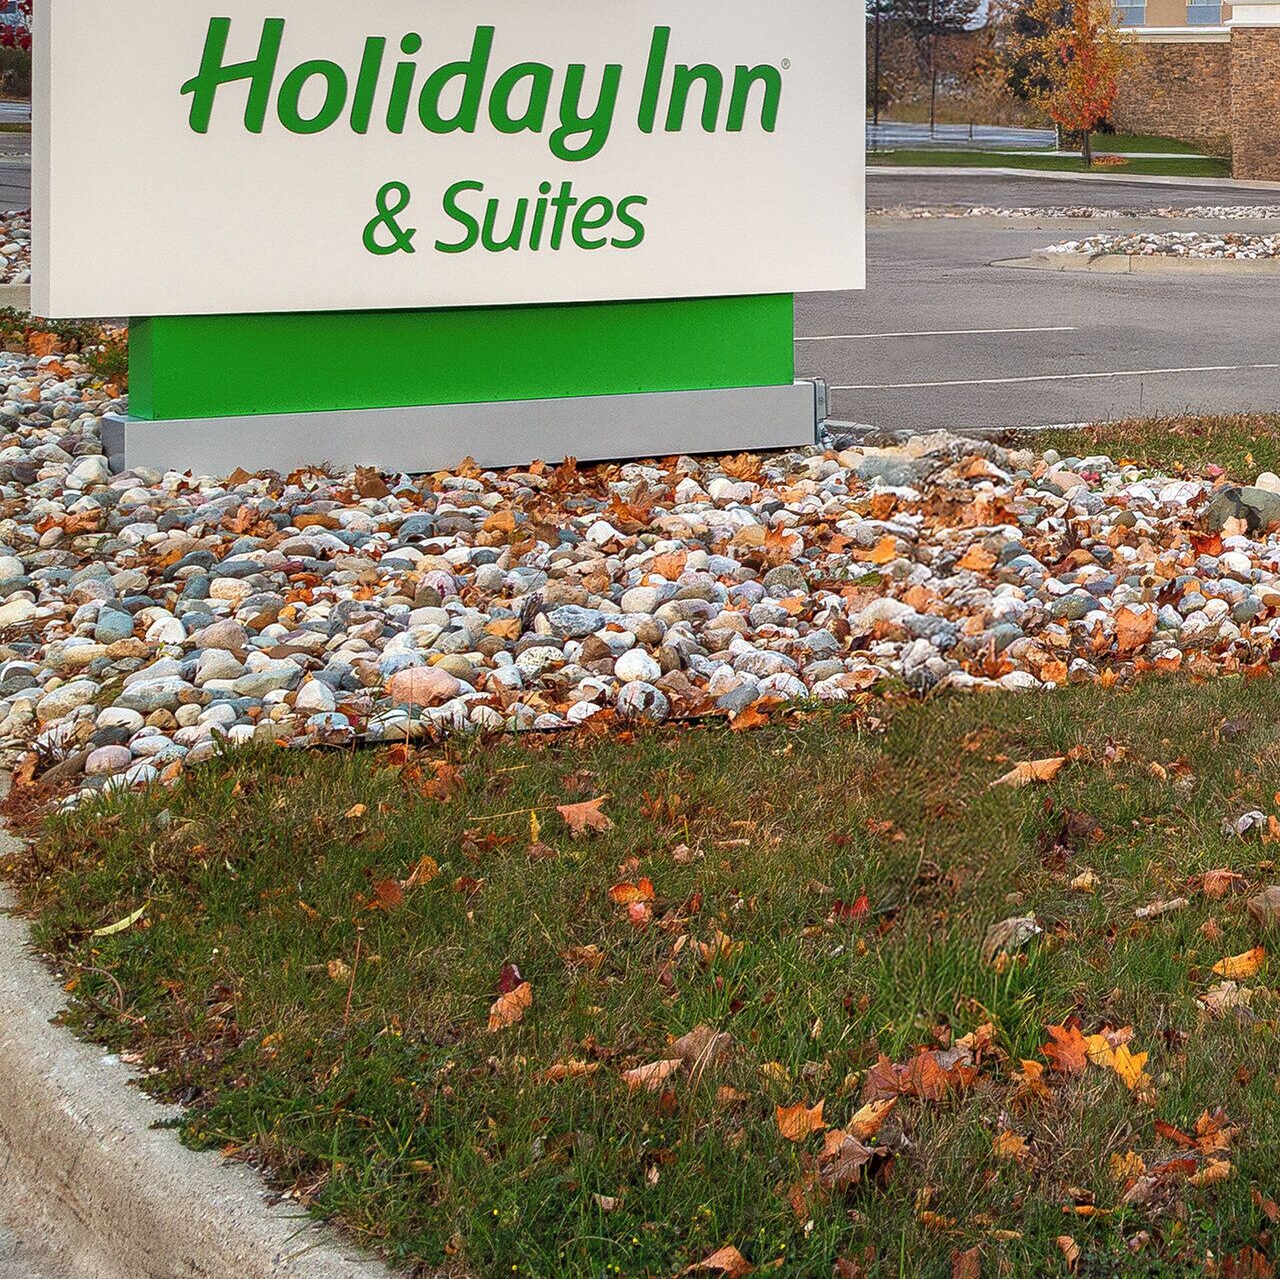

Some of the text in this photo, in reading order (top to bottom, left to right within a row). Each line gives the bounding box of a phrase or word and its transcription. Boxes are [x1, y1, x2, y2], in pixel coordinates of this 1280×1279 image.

[180, 17, 623, 162] Holiday
[361, 180, 648, 256] & Suites
